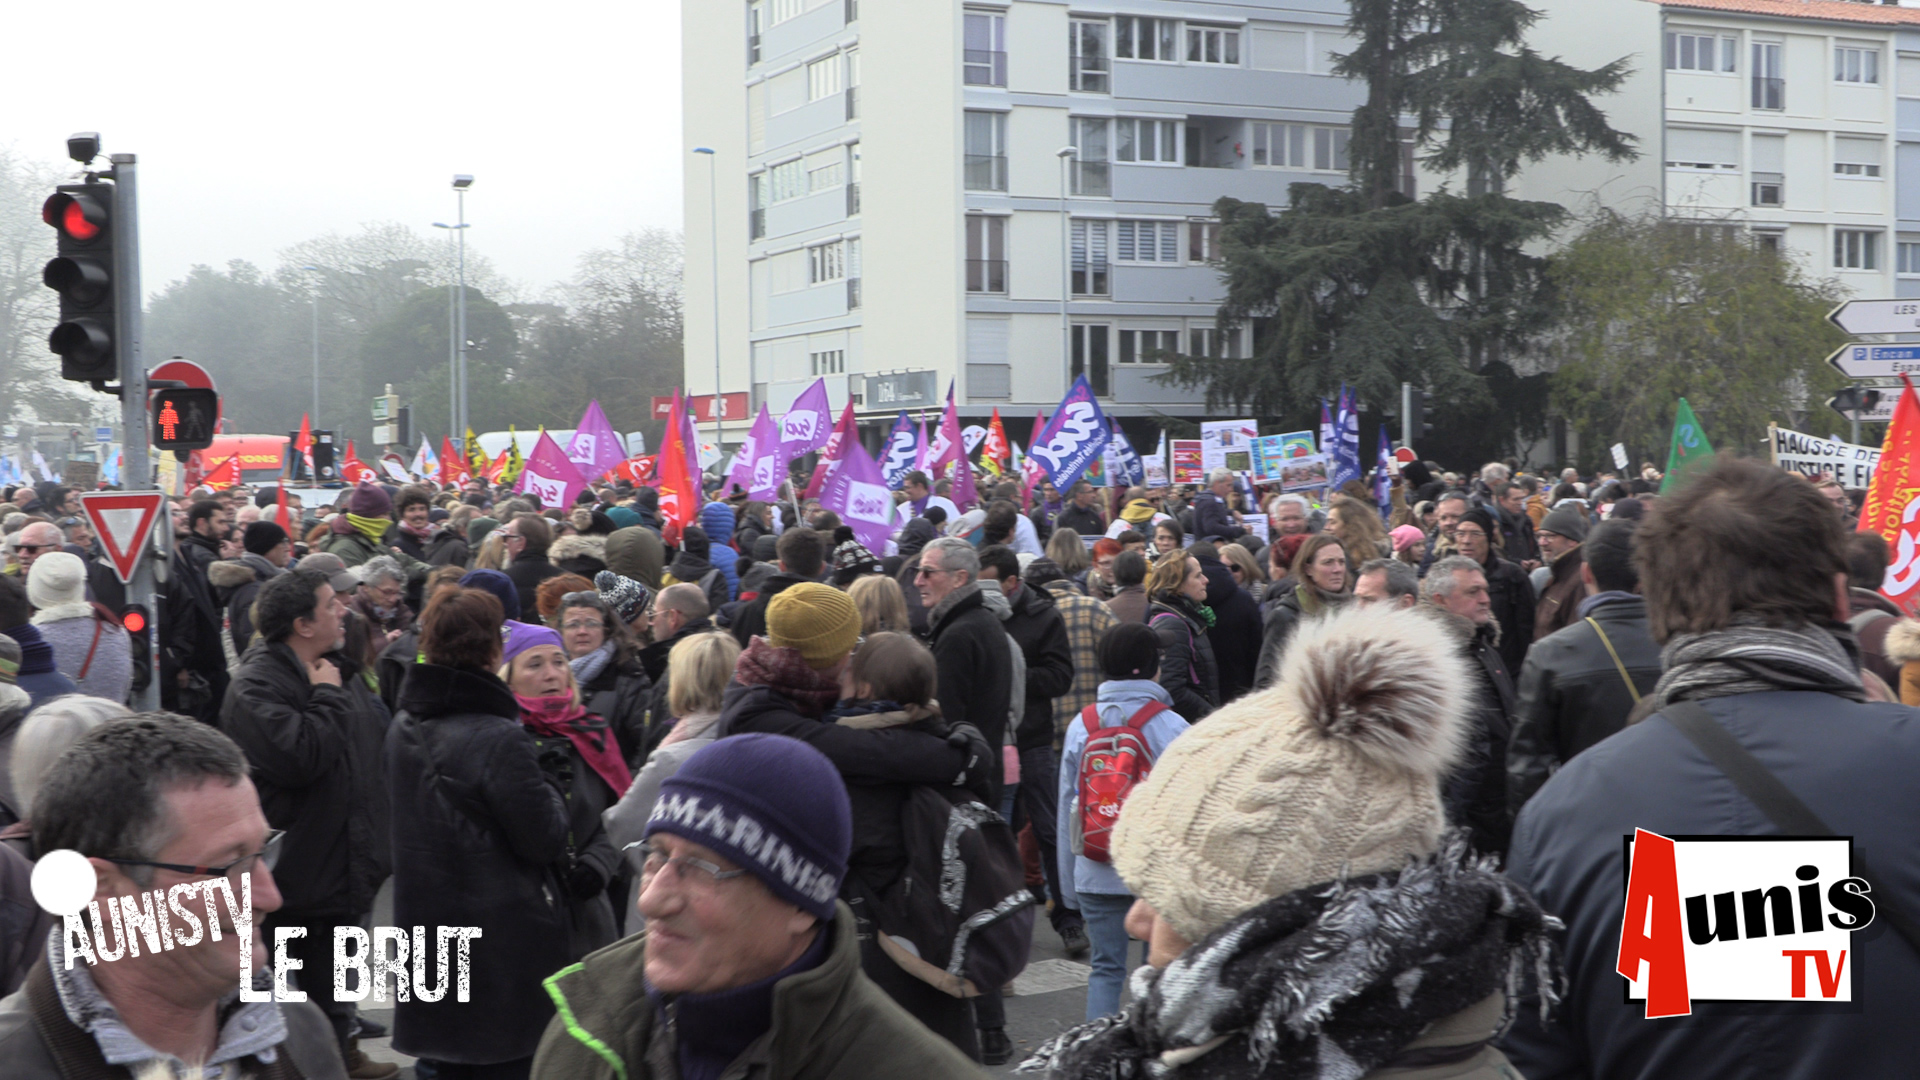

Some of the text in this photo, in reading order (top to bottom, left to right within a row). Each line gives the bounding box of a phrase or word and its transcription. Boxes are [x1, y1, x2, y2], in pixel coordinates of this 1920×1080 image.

[1893, 304, 1918, 315] LES
[1873, 349, 1914, 359] Encan
[1775, 431, 1848, 457] HAUSSE
[1098, 802, 1121, 818] cgt
